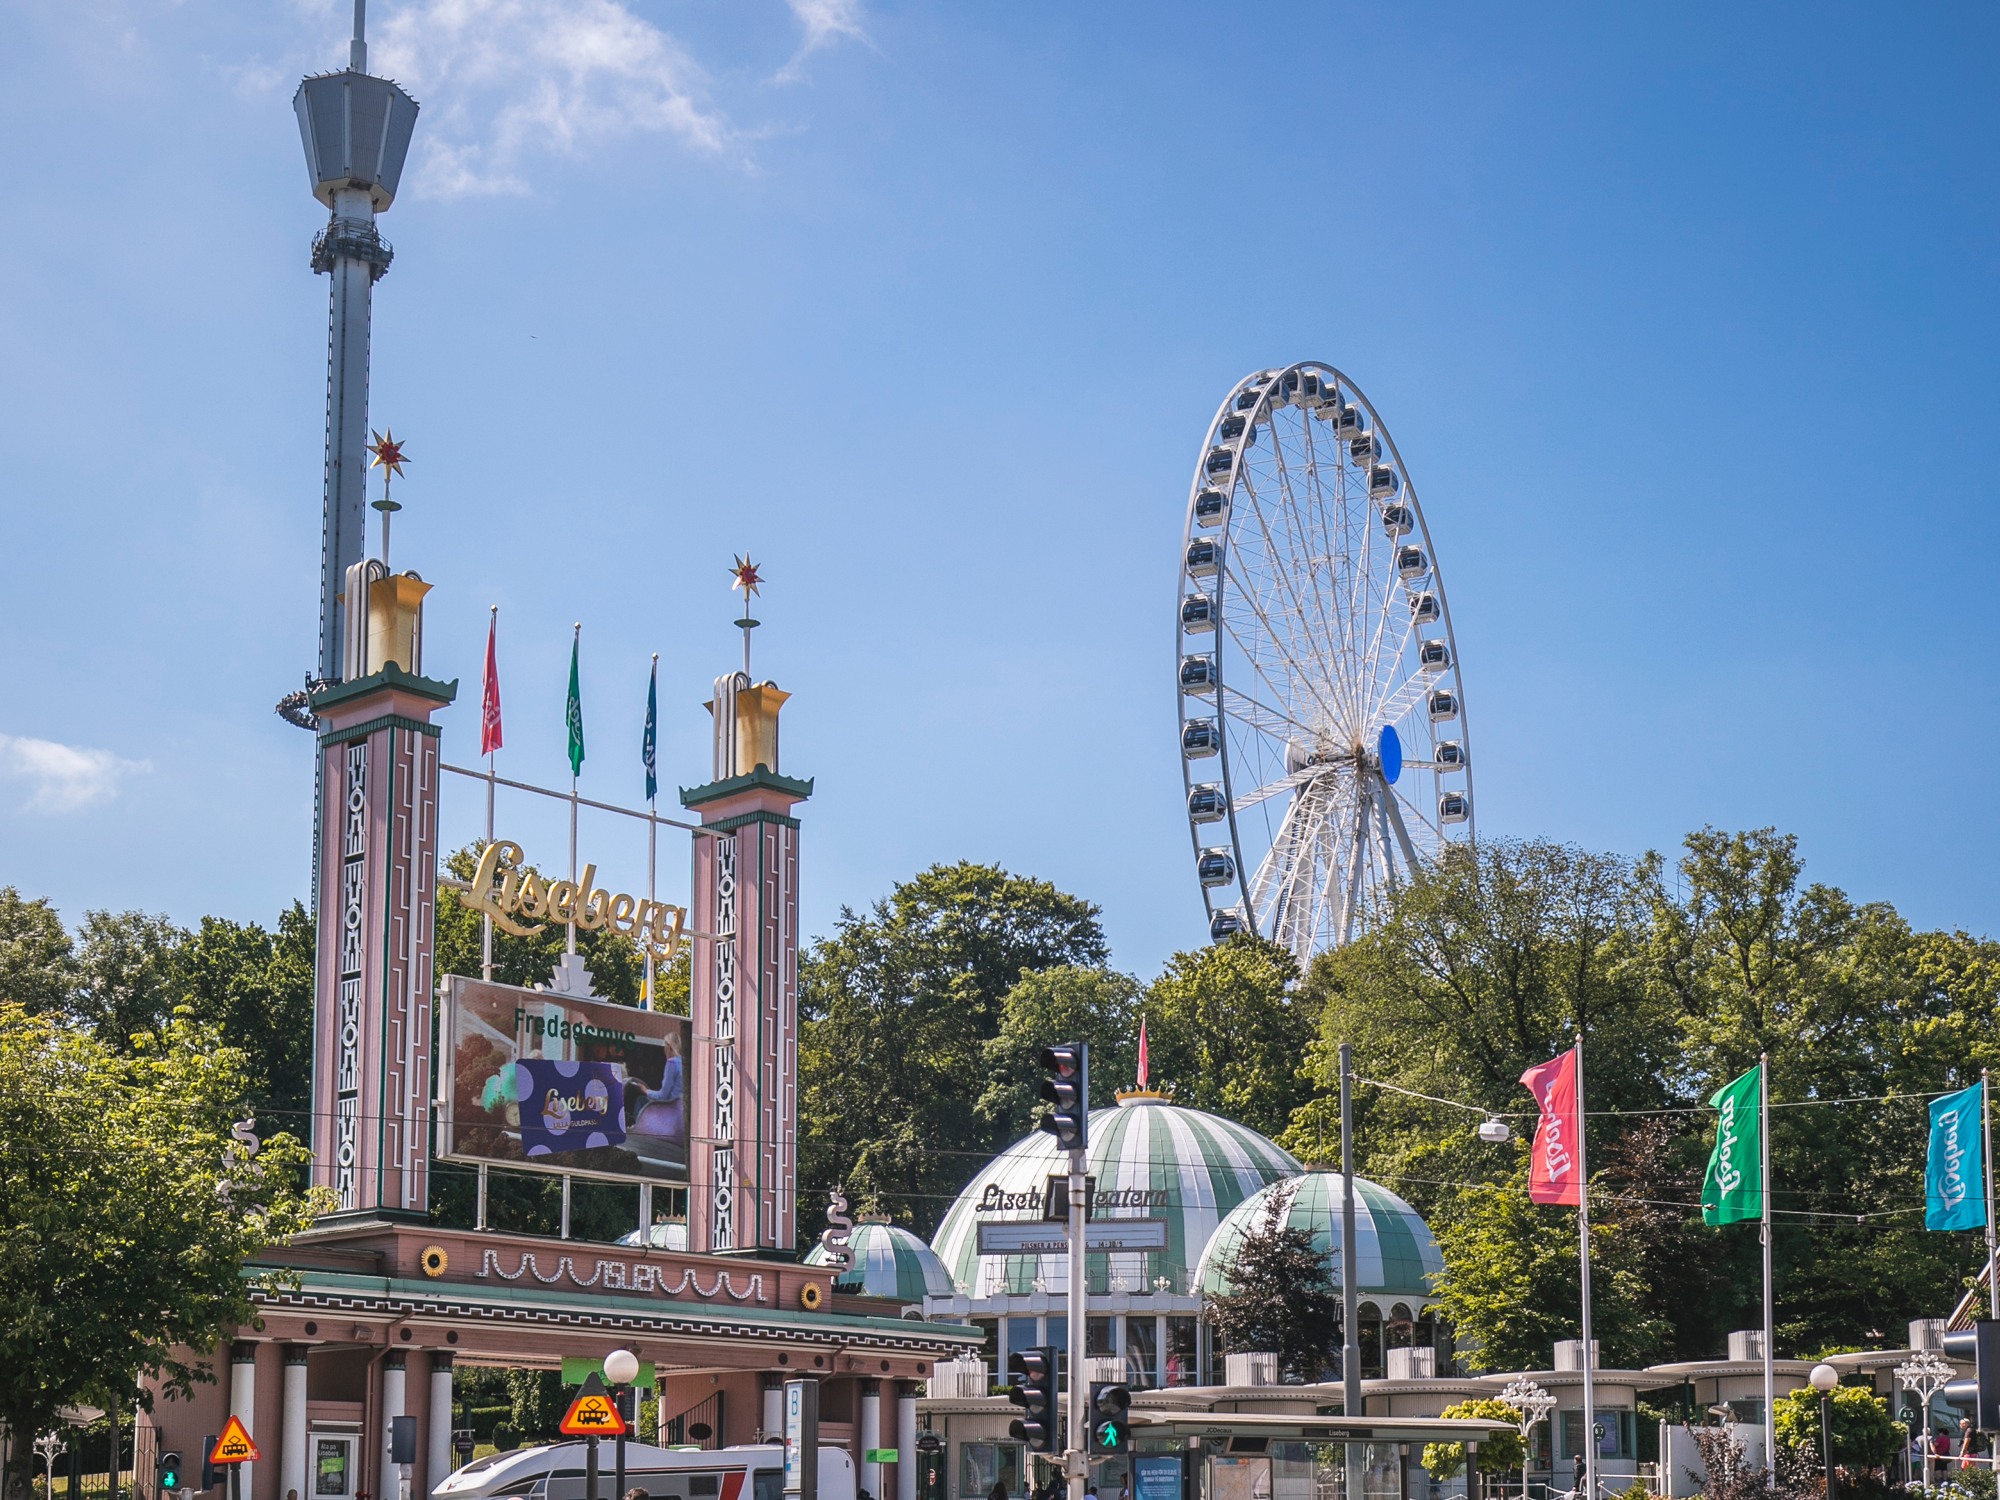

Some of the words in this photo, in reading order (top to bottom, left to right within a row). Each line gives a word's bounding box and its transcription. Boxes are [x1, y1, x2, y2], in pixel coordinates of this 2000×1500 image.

[459, 840, 687, 961] Liseberg
[514, 1007, 636, 1049] Fredagsmys
[540, 1088, 609, 1119] Liseberg
[975, 1183, 1168, 1213] Lisebeatern
[791, 1390, 798, 1415] B
[1328, 1429, 1350, 1438] Liseberg
